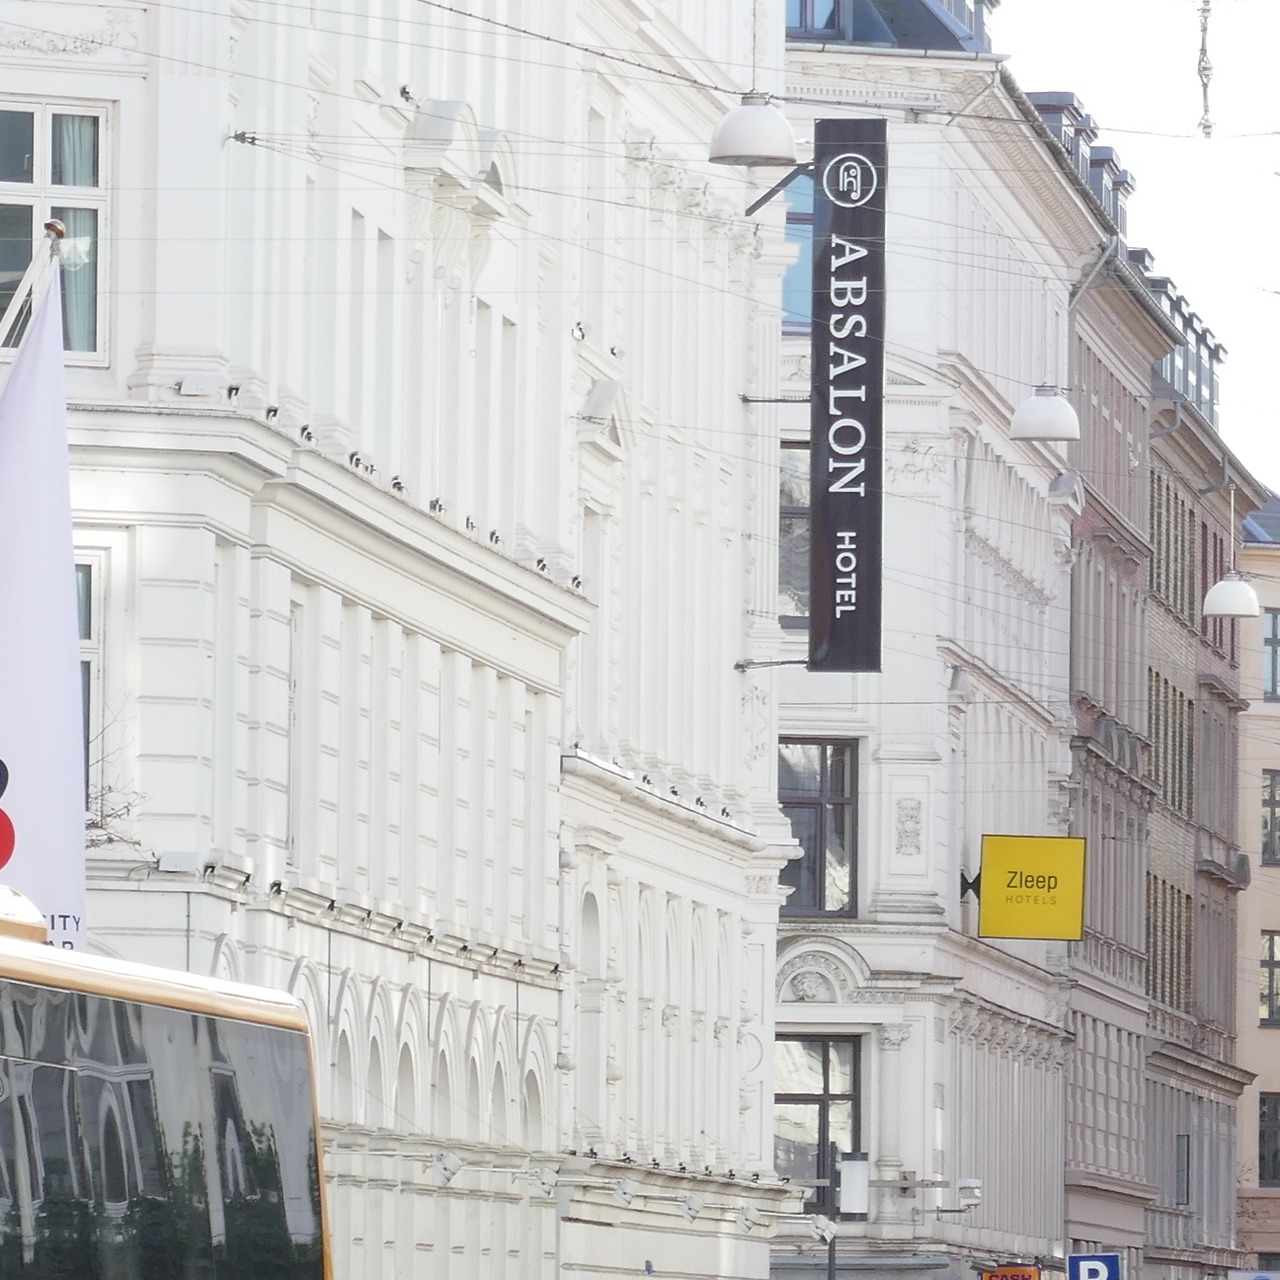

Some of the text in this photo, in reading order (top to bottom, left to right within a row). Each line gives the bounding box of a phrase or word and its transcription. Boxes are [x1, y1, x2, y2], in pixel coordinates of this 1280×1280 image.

[828, 233, 868, 619] ABSALON HOTEL
[1006, 871, 1057, 893] Zleep
[1005, 895, 1057, 905] HOTELS
[42, 914, 81, 931] ITY
